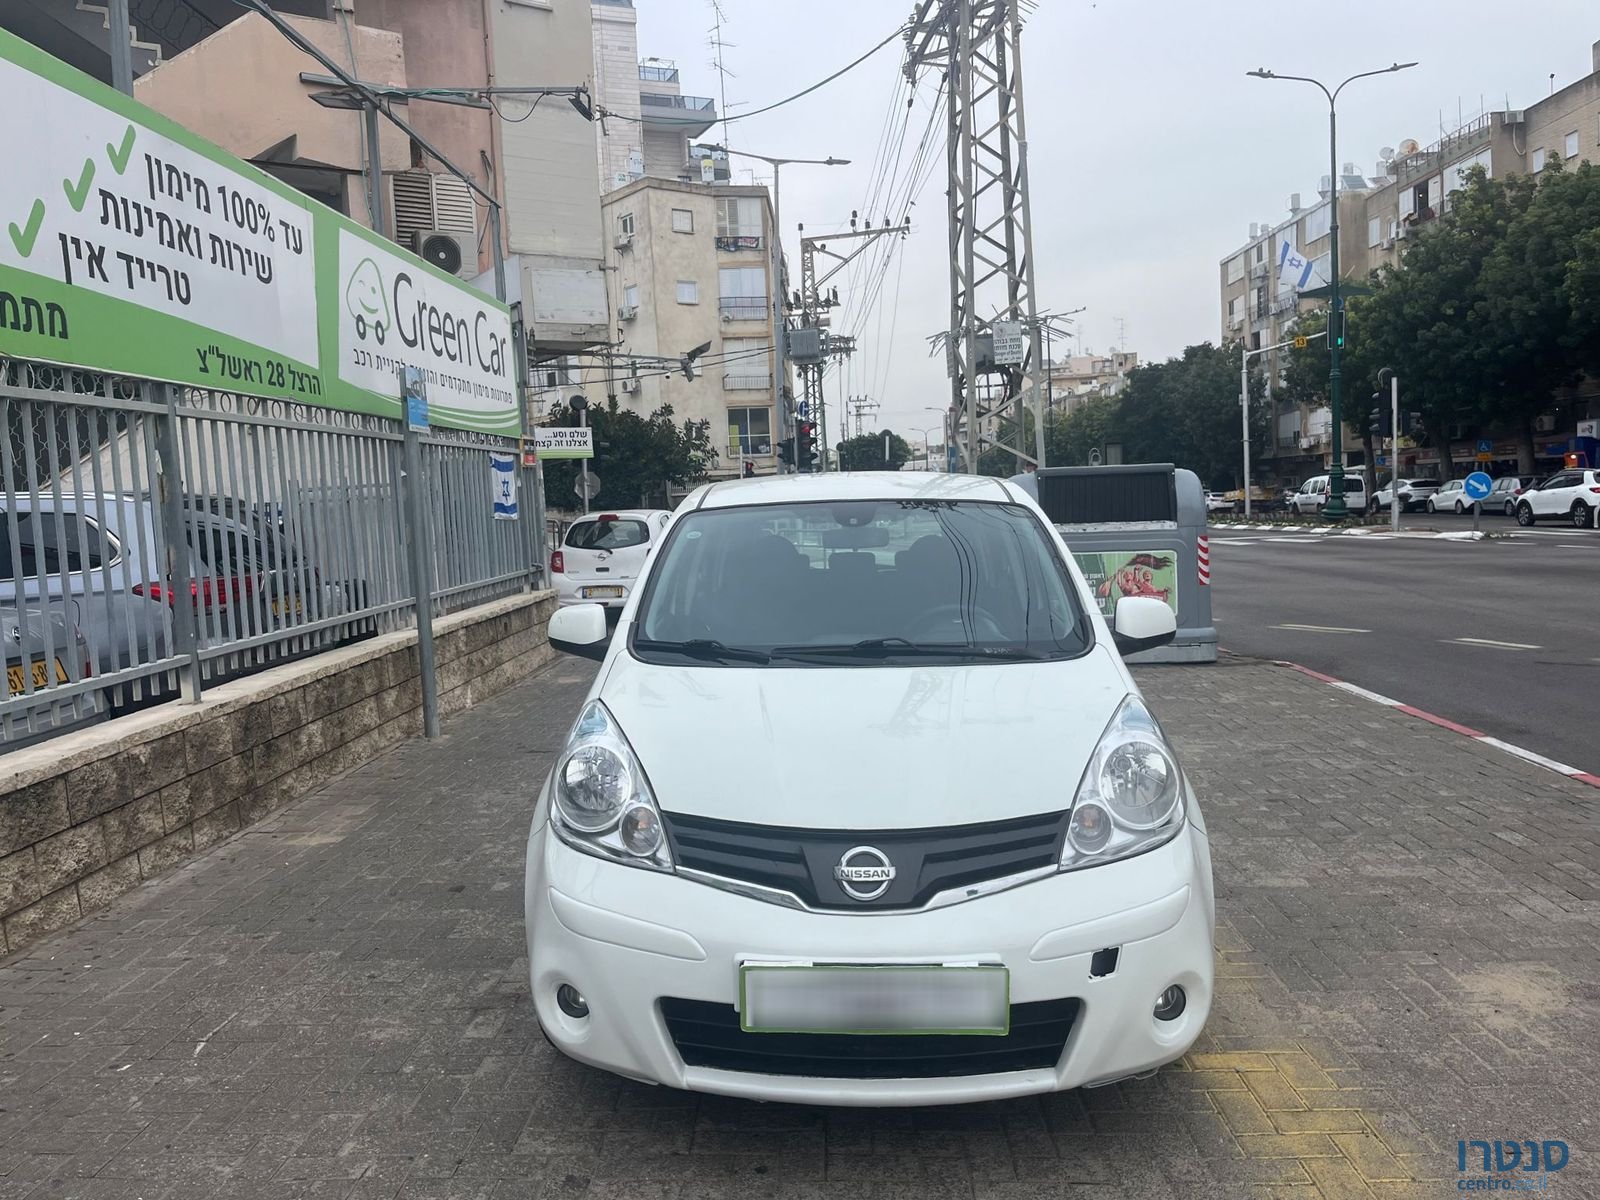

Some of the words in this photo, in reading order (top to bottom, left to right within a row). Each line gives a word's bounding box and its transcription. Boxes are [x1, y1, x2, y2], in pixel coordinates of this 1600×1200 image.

[145, 153, 211, 214] מימון
[98, 187, 202, 260] ואמינות
[217, 185, 275, 242] 100%
[279, 219, 303, 255] עד
[58, 232, 109, 285] אין
[209, 233, 273, 285] שירות
[116, 251, 191, 305] טרייד
[393, 272, 472, 366] Green
[474, 310, 506, 378] Car
[1296, 338, 1304, 346] 13
[266, 360, 285, 388] 28
[353, 348, 373, 368] רכב
[288, 363, 321, 395] הרצל
[566, 439, 588, 447] אצלנו
[569, 430, 588, 438] שלם
[840, 869, 890, 878] NISSAN
